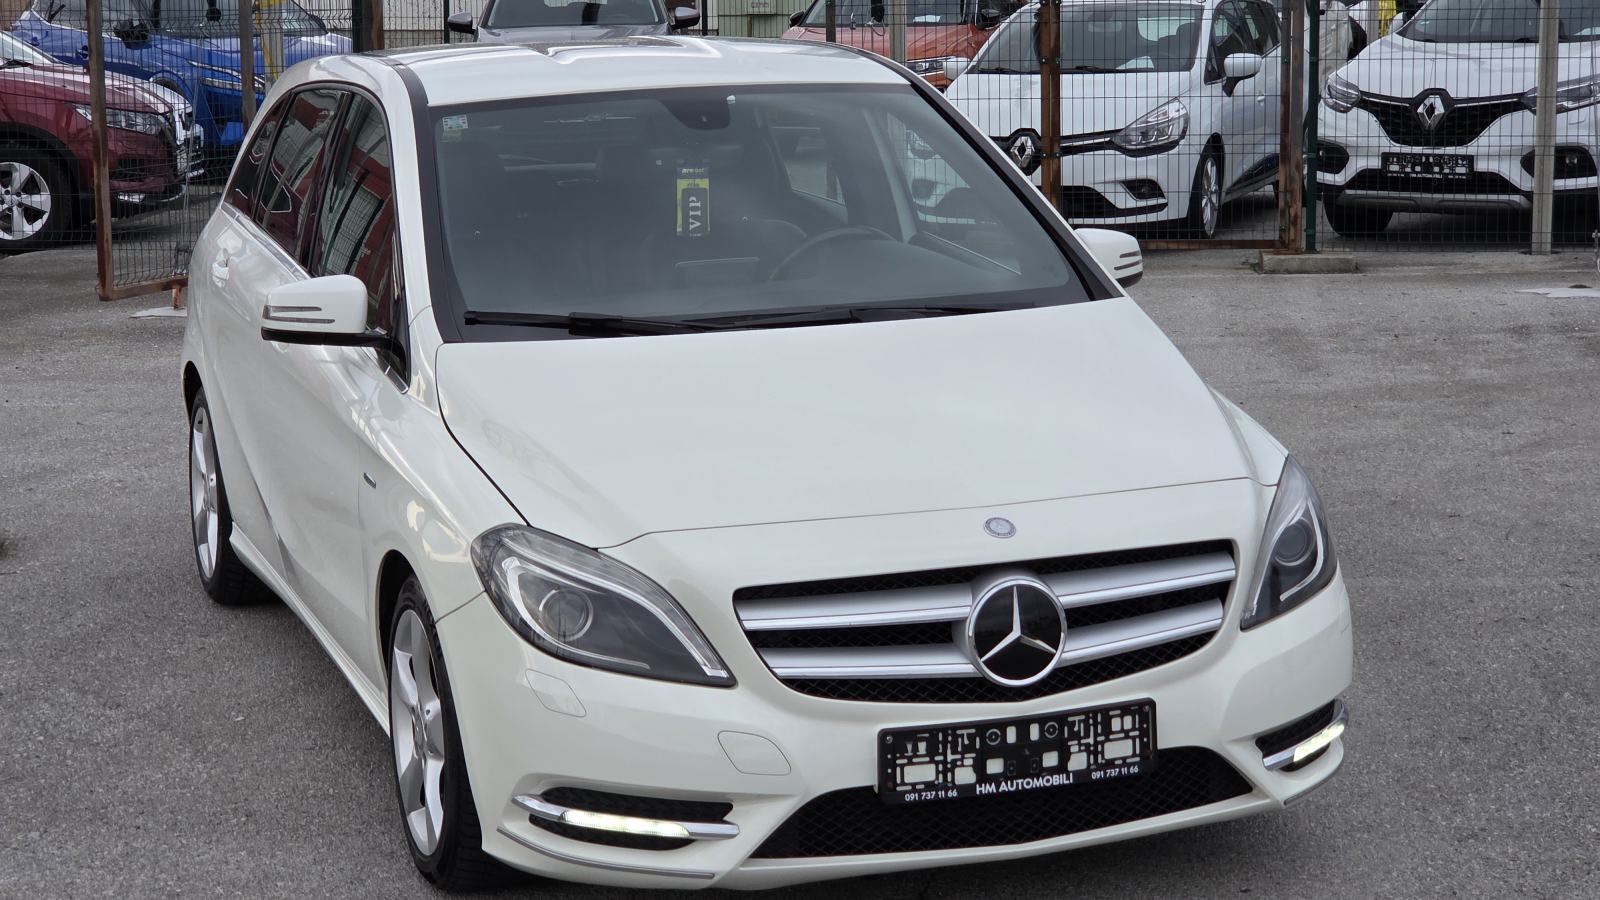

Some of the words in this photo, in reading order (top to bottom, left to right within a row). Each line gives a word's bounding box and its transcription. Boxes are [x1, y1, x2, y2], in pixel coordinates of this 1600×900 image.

[688, 196, 702, 230] VIP
[1091, 770, 1104, 780] 091
[1105, 768, 1119, 778] 737
[1121, 766, 1128, 775] 11
[1129, 764, 1139, 774] 66
[975, 781, 996, 795] HM
[999, 773, 1073, 793] AUTOMOBILI
[904, 792, 919, 802] 091
[921, 791, 936, 800] 737
[937, 790, 945, 799] 11
[947, 789, 958, 798] 66
